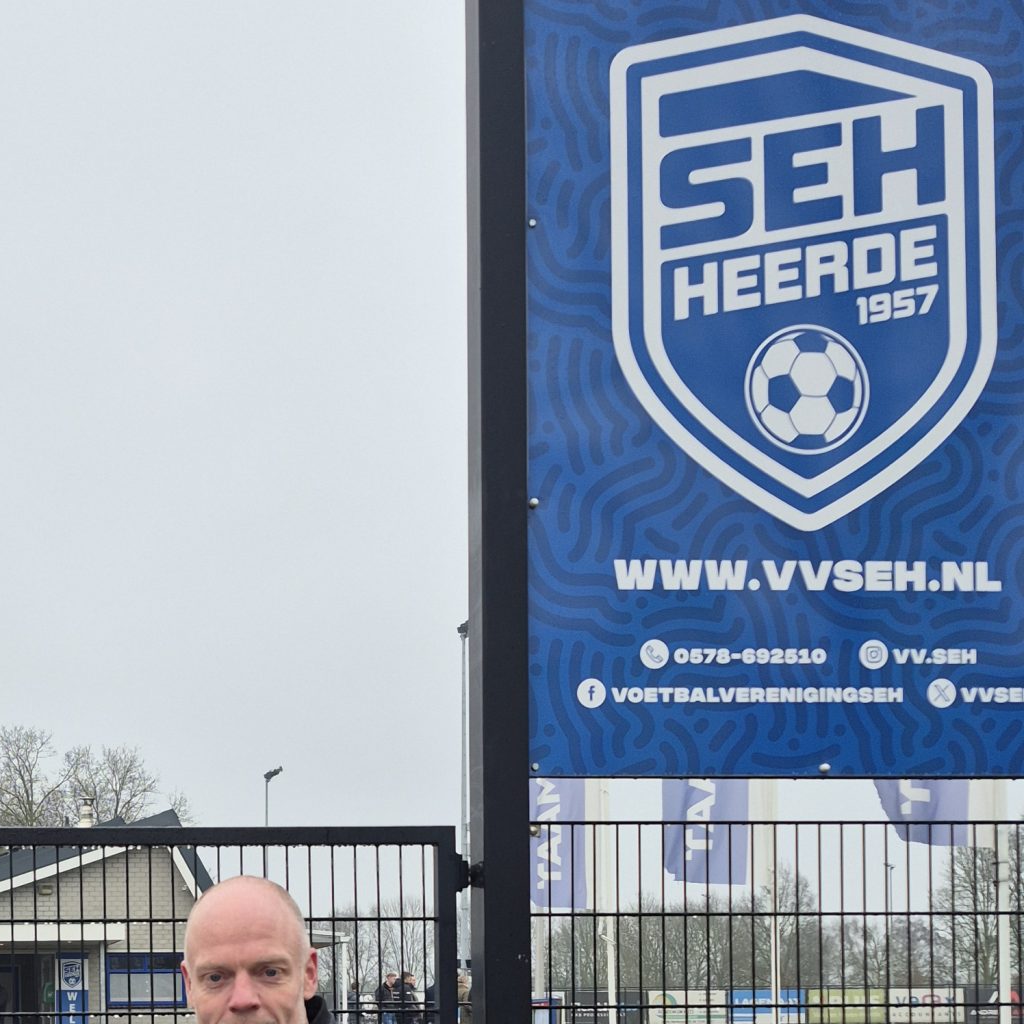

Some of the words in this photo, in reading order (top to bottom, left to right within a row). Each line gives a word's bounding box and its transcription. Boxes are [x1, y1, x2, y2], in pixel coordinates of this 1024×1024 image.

[659, 104, 946, 250] SEH
[674, 224, 939, 321] HEERDE
[856, 284, 939, 325] 1957
[613, 559, 1002, 592] WWW.VVSEH.NL
[673, 647, 828, 665] 0578-692510
[892, 647, 977, 665] VV.SEH
[610, 686, 904, 704] VOETBALVERENIGINGSEH
[959, 686, 1024, 704] VVSE
